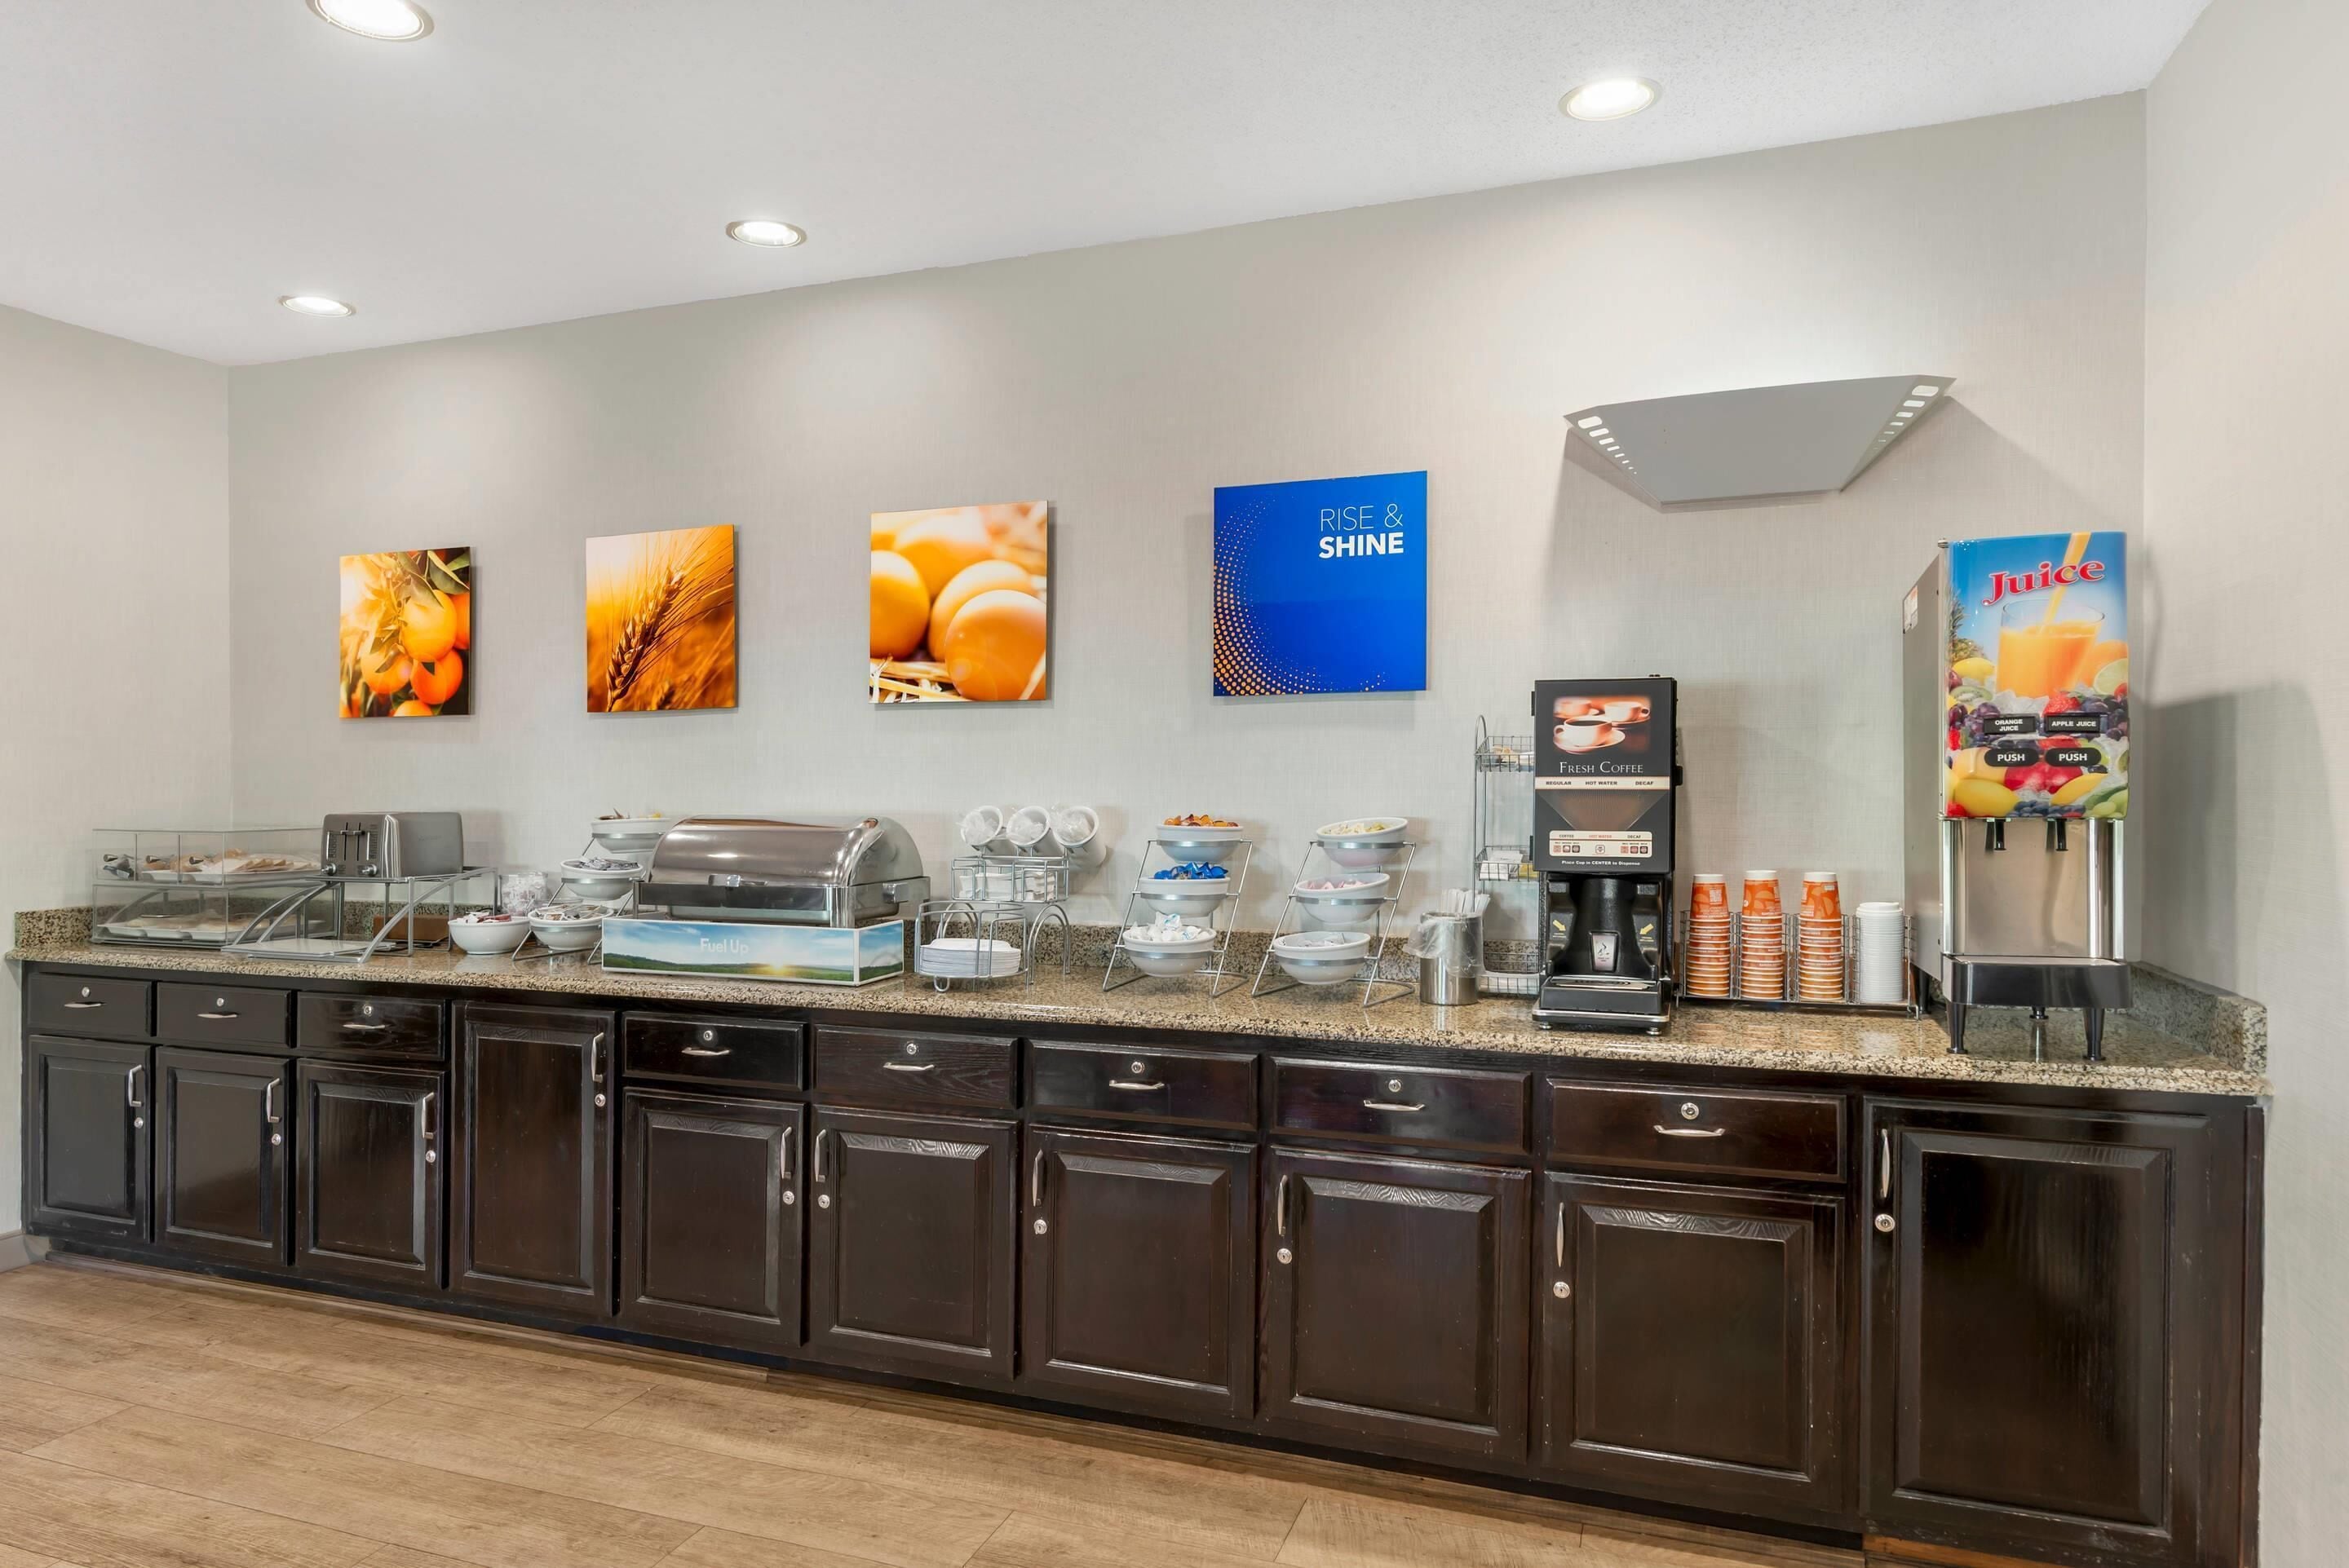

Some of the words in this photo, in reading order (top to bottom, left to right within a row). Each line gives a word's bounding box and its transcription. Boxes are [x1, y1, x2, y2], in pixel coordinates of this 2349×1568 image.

[1320, 505, 1374, 532] RISE
[1384, 503, 1404, 528] &
[1318, 532, 1405, 559] SHINE
[1981, 560, 2105, 606] Juice
[1997, 753, 2025, 762] PUSH
[2059, 753, 2087, 762] PUSH
[1559, 761, 1595, 774] FRESH
[1599, 761, 1644, 774] COFFEE
[700, 938, 728, 953] Fuel
[730, 939, 750, 956] Up
